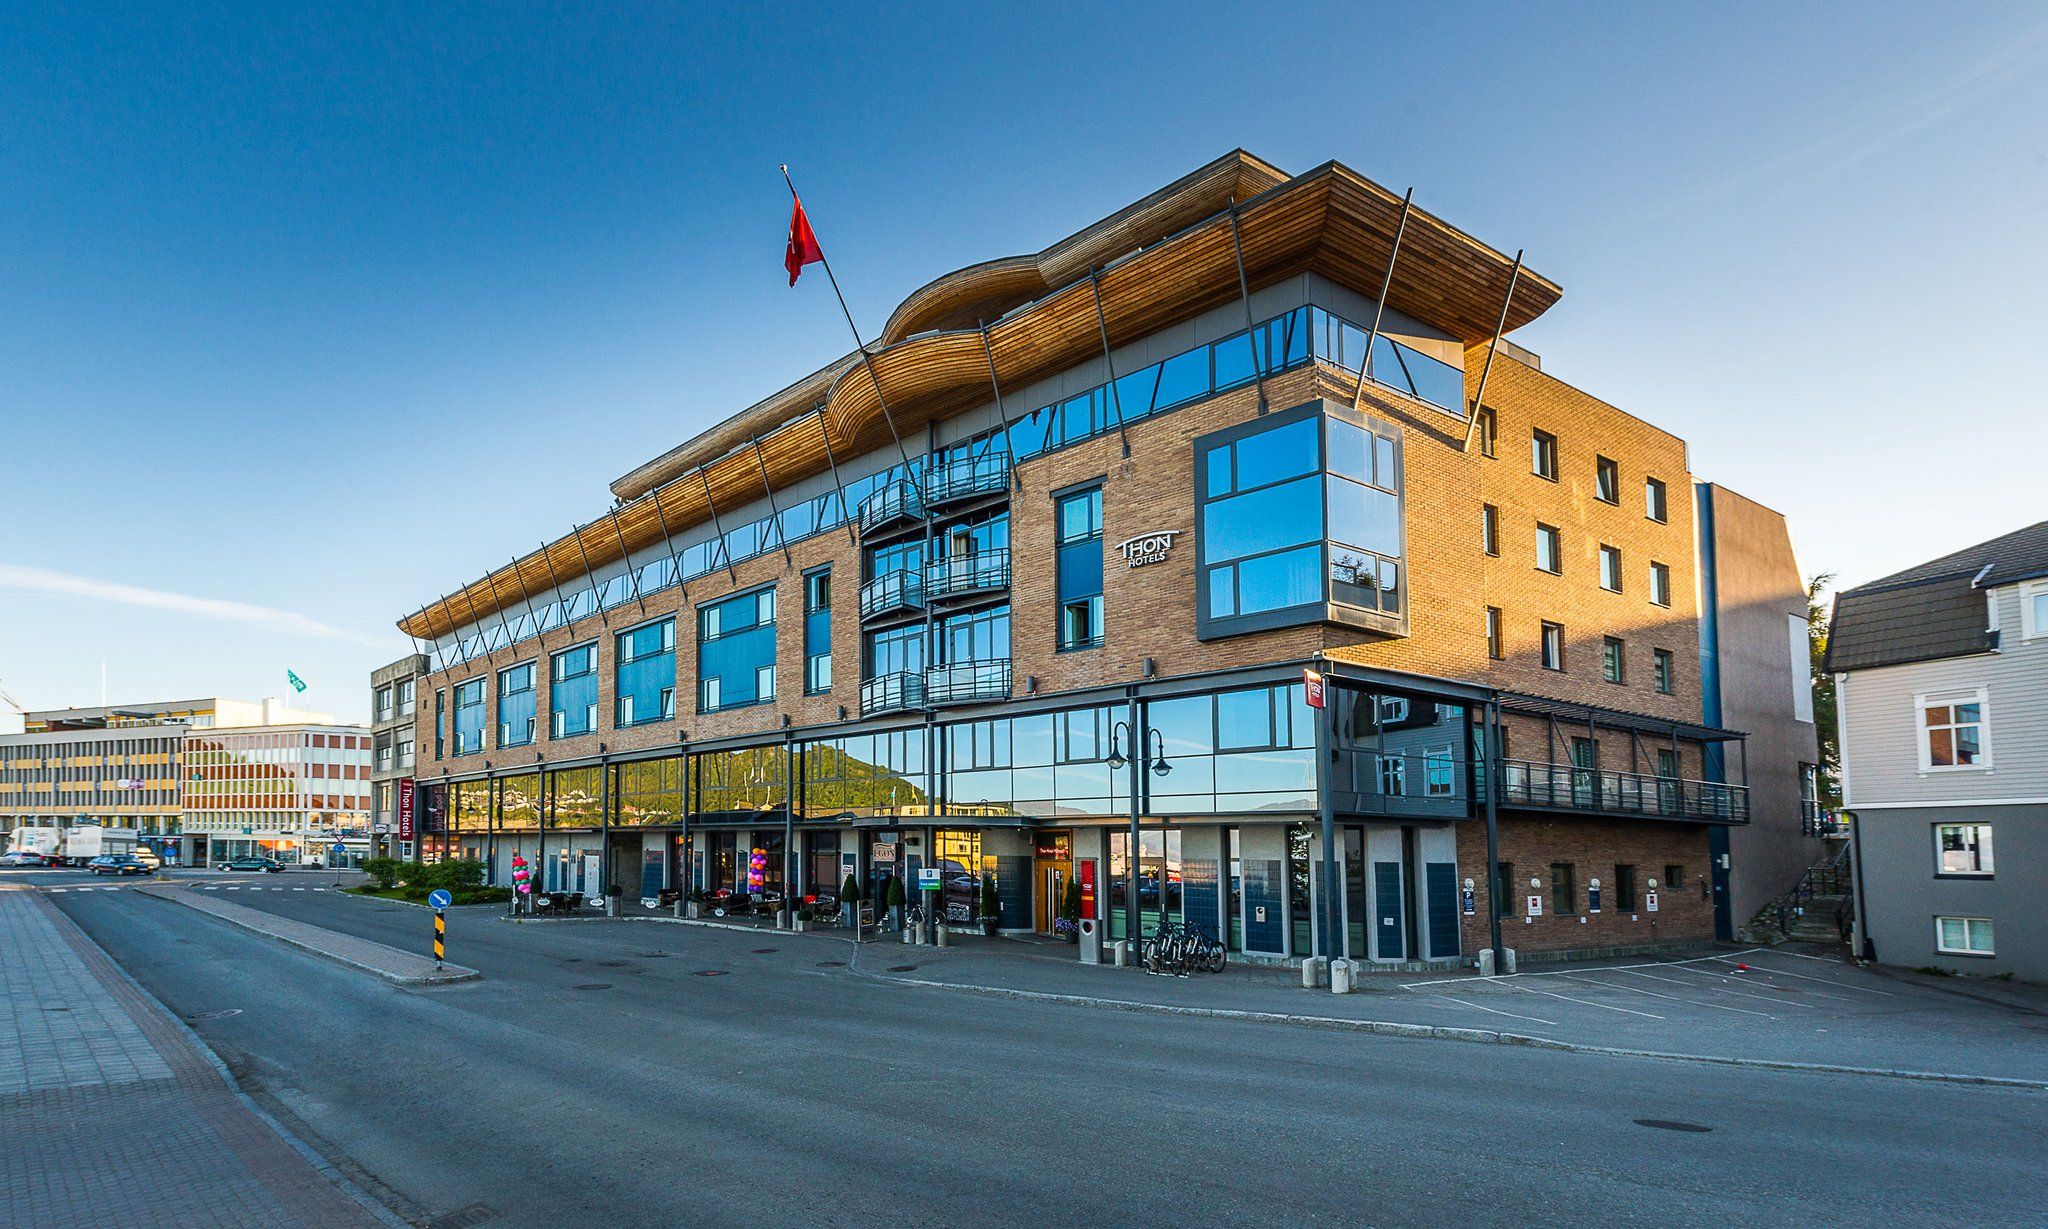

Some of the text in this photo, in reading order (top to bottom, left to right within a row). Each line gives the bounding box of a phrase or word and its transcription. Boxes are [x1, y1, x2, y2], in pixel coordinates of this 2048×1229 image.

[1115, 530, 1180, 559] THON
[1128, 550, 1167, 568] HOTELS
[402, 788, 412, 836] Thon Hotels
[874, 848, 895, 858] EGON
[1466, 891, 1471, 899] P
